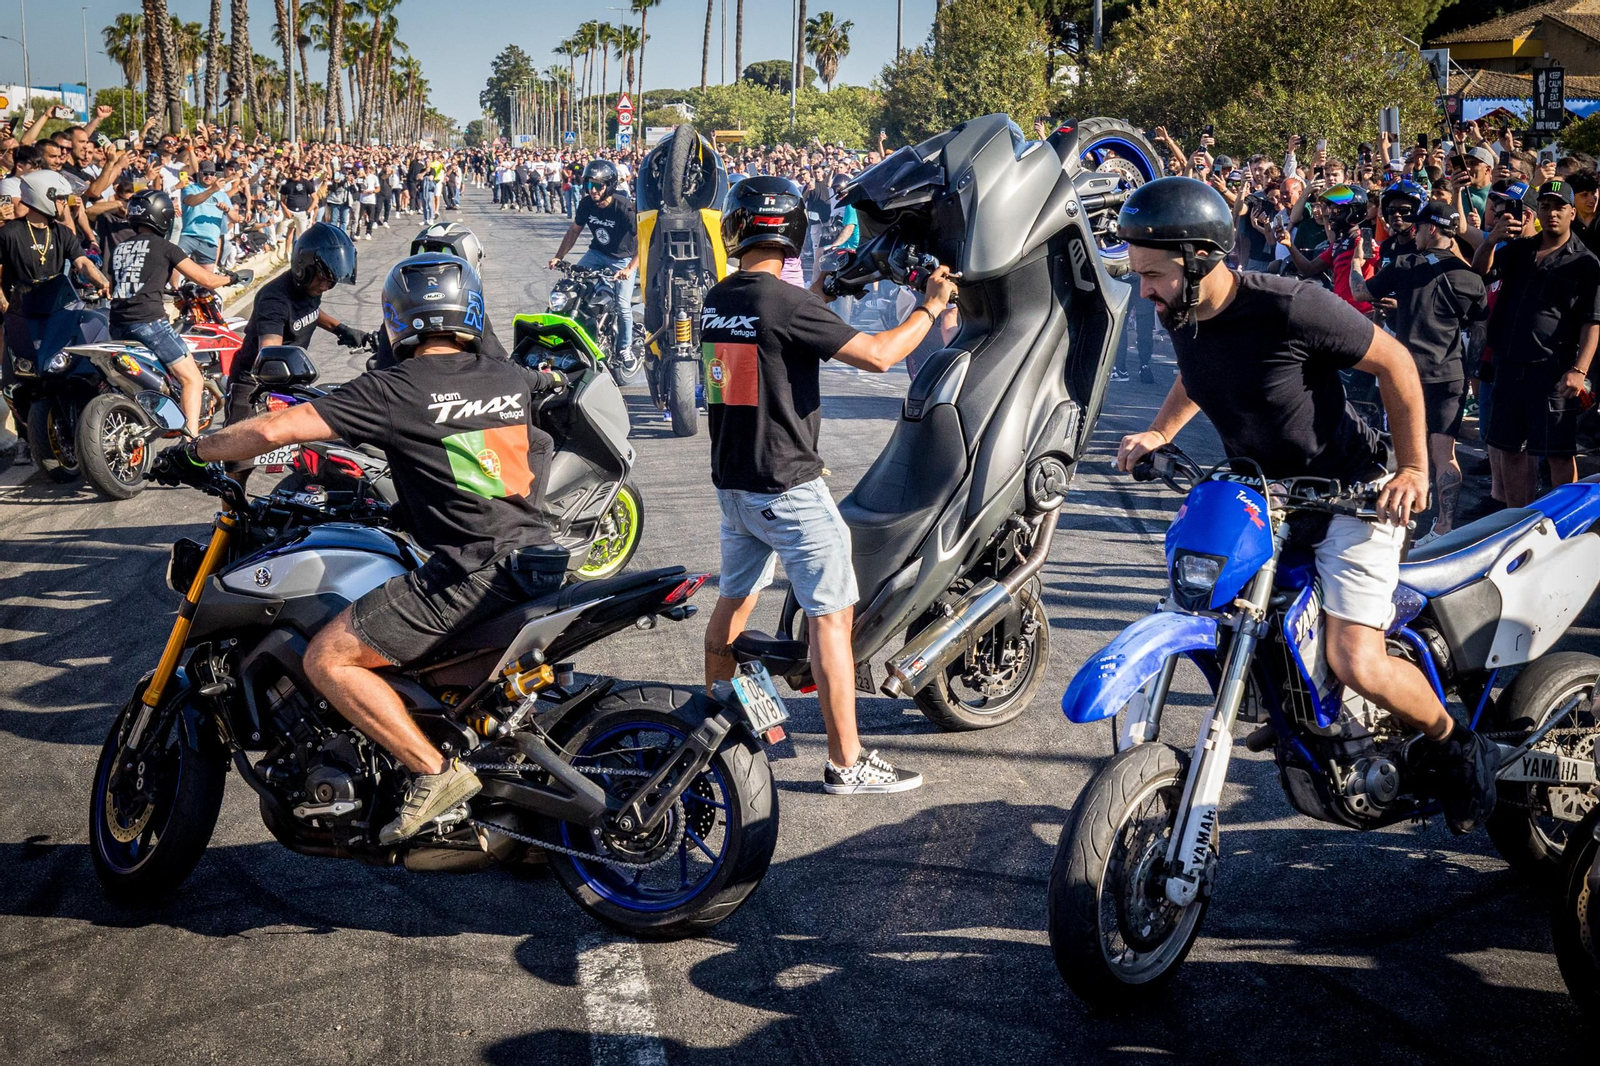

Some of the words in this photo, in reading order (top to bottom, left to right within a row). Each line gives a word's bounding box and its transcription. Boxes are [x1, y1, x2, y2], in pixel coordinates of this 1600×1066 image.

[1548, 80, 1562, 88] CALM
[1550, 93, 1559, 101] EAT
[1547, 101, 1561, 109] PIZZA
[1535, 121, 1545, 130] MR
[1545, 121, 1560, 130] WOLF
[114, 239, 151, 255] REAL
[112, 282, 145, 299] NLY
[703, 306, 716, 314] Team
[300, 305, 321, 328] YAMA
[701, 313, 760, 331] TMAX
[730, 328, 757, 338] Portugal
[430, 392, 461, 403] Team
[427, 393, 522, 424] TMAX
[499, 408, 525, 420] Portugal
[1522, 756, 1579, 781] YAMAHA
[1192, 806, 1217, 865] YAMAH
